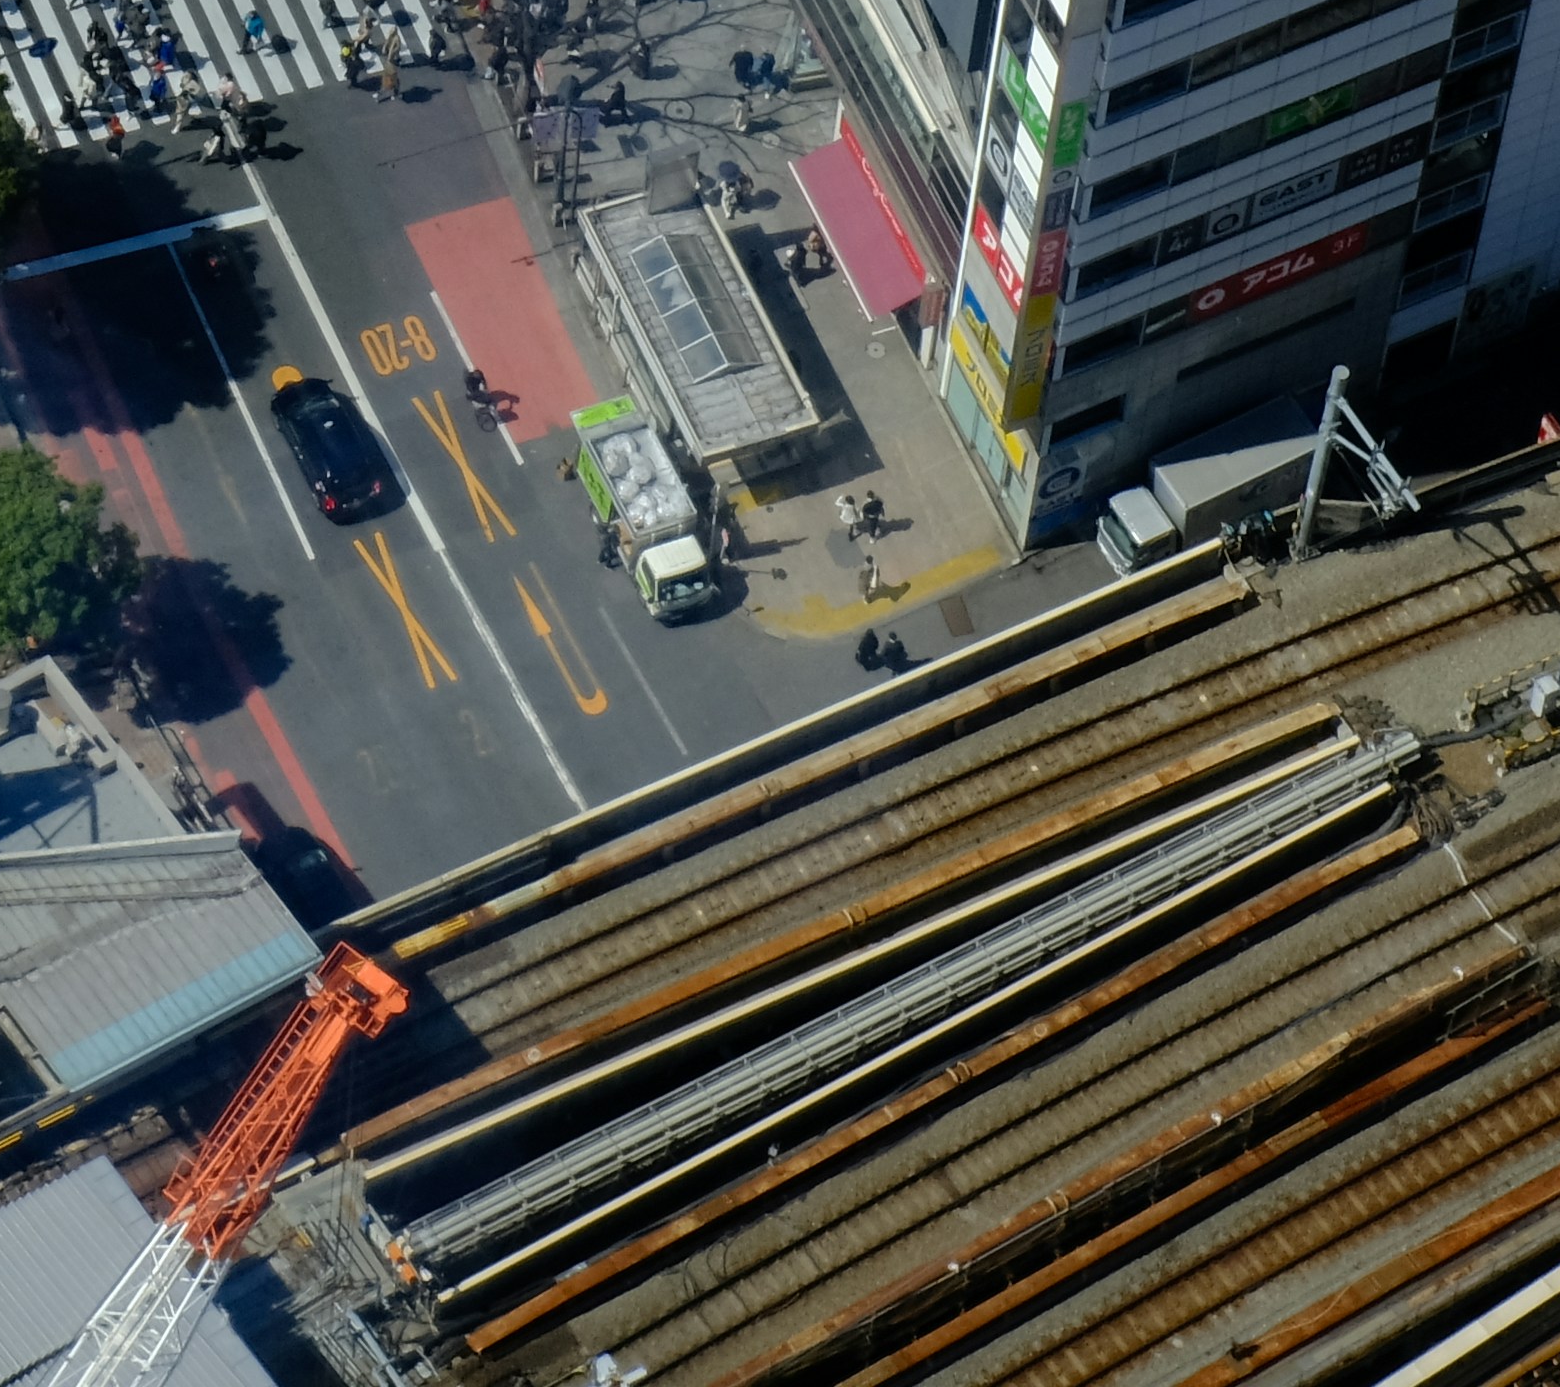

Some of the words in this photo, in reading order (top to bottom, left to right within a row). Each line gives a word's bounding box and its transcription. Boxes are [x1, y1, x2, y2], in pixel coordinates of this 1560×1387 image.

[1242, 252, 1316, 295] アコム
[358, 314, 438, 377] 8-20
